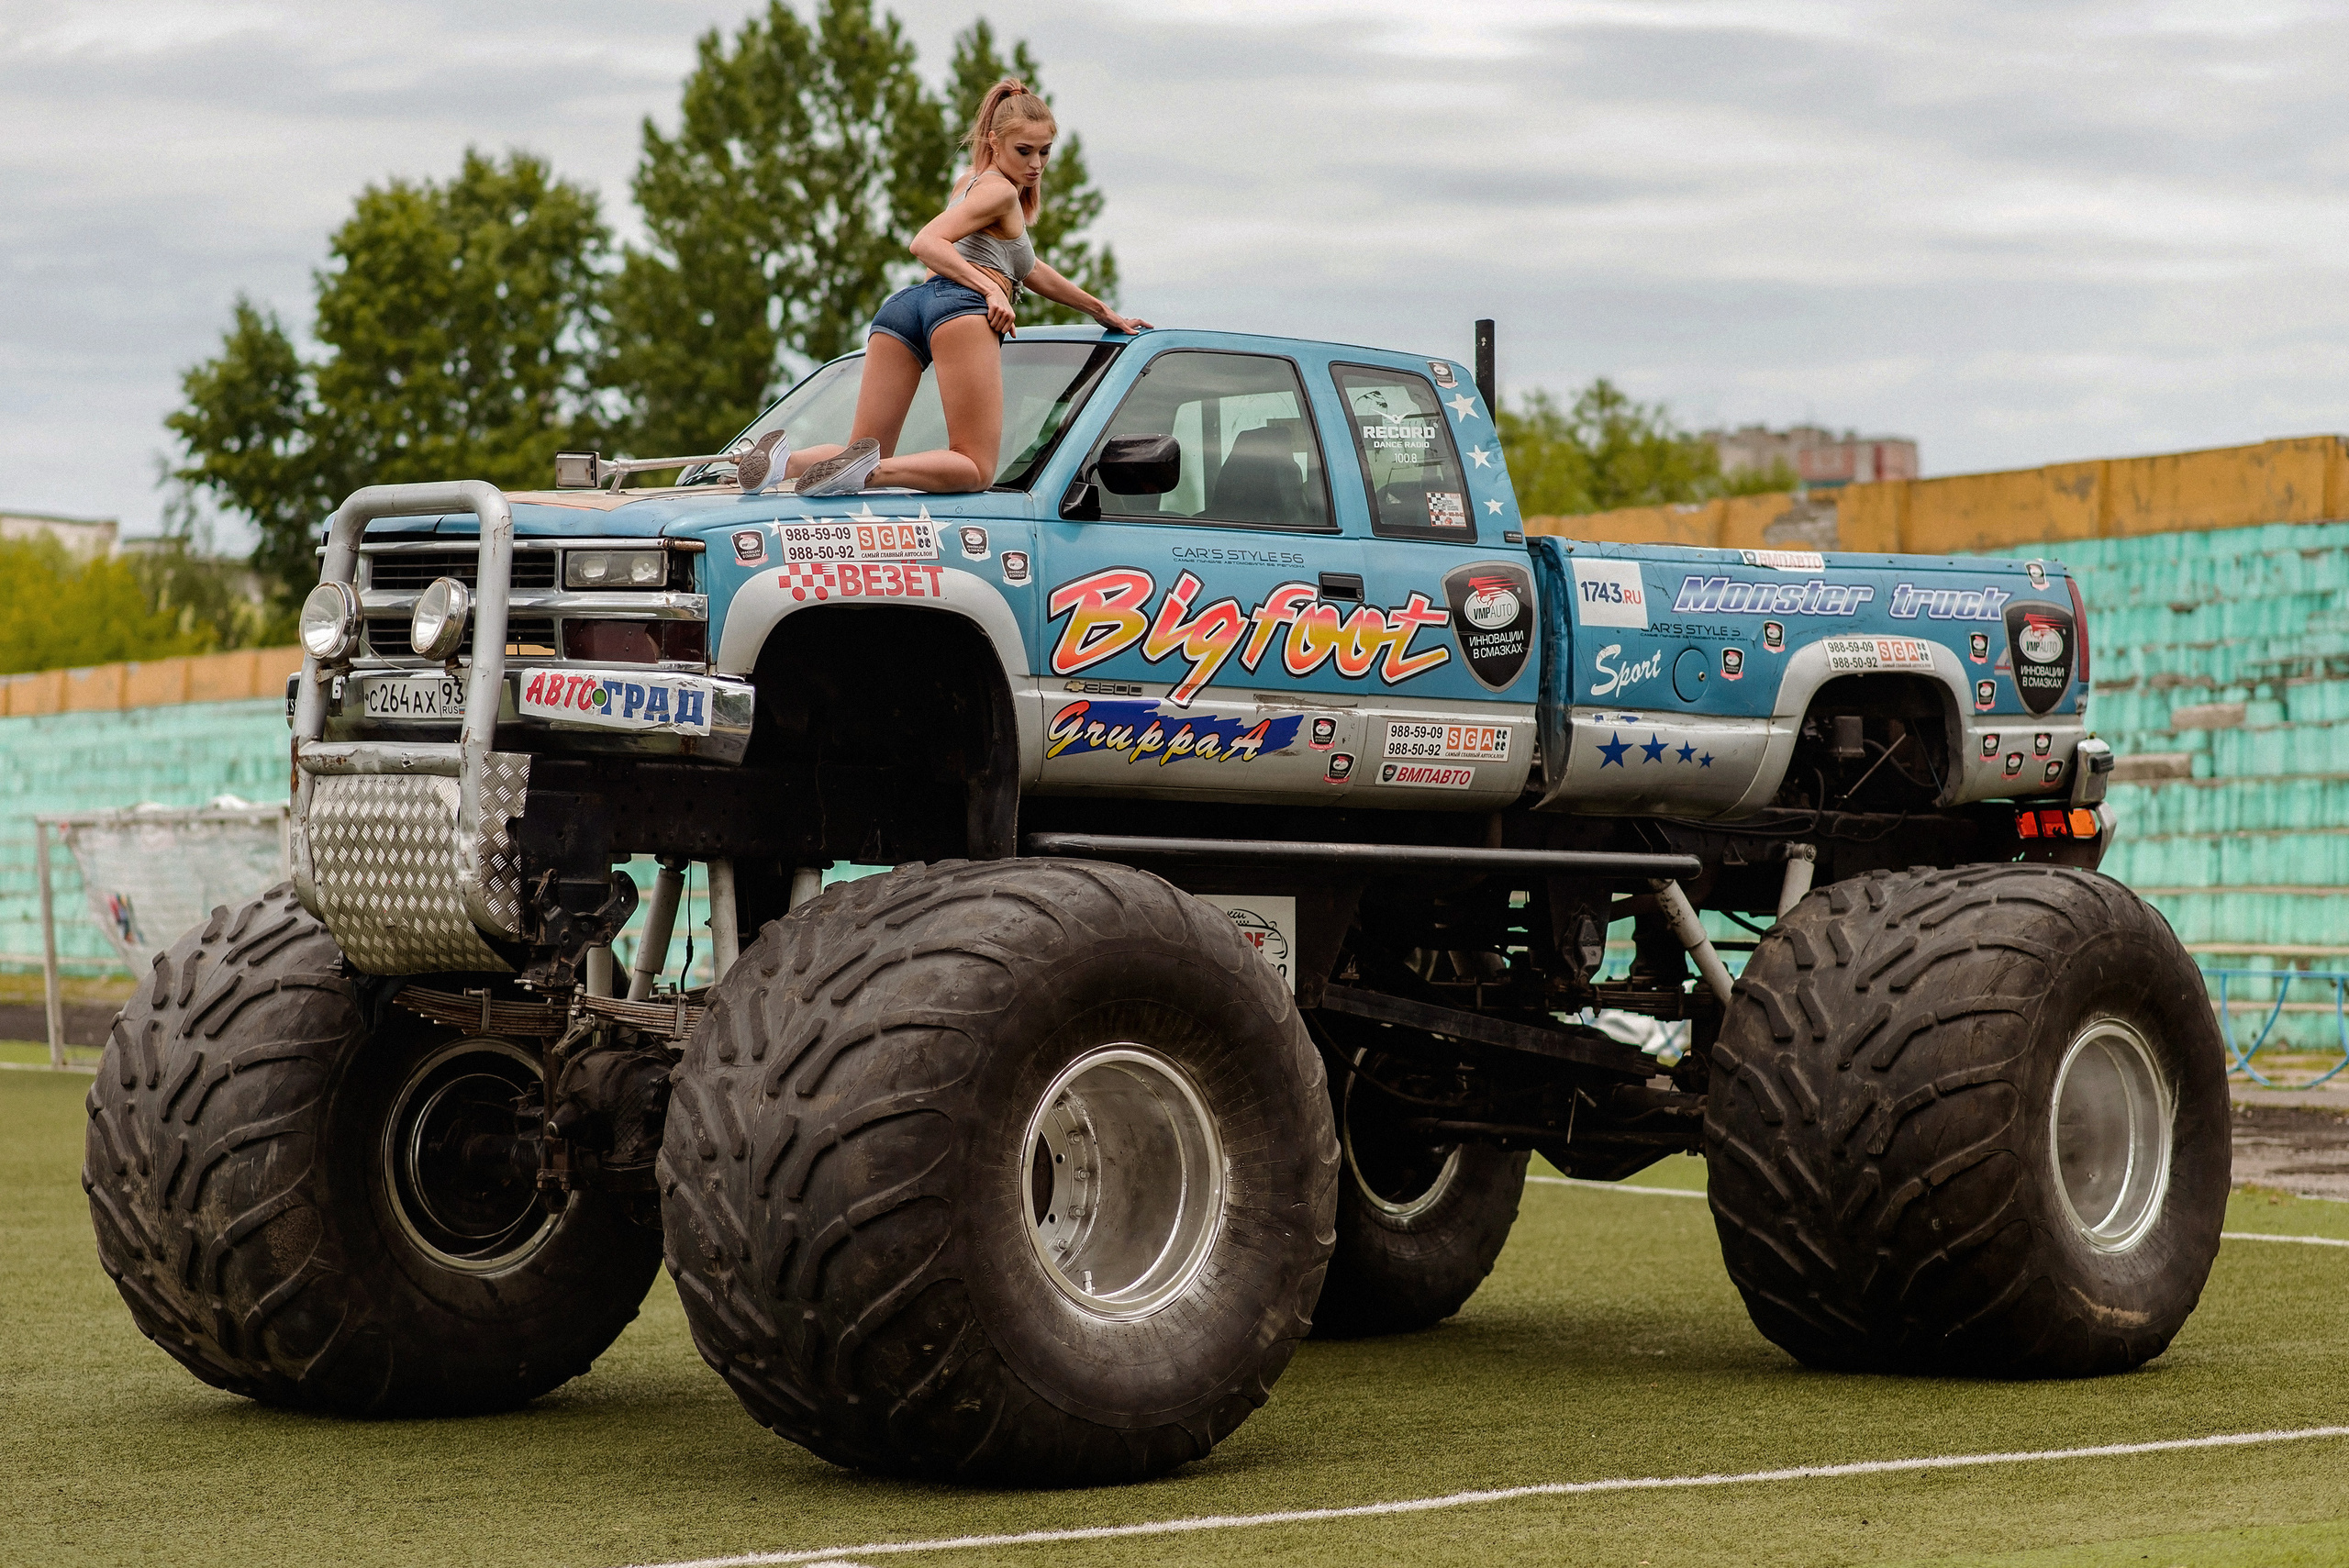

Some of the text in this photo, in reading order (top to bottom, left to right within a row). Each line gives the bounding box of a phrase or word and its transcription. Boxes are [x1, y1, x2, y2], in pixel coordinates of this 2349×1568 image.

[1364, 426, 1436, 439] RECORD
[1394, 453, 1418, 462] 100.8
[785, 527, 852, 541] 988-59-09
[859, 527, 916, 549] SGA
[788, 545, 855, 561] 988-50-92
[1172, 547, 1304, 563] CAR'S STYLE 56
[1580, 581, 1642, 605] 1743.RU
[1671, 574, 2013, 622] Monster truck
[1048, 567, 1451, 706] Bigfoot
[1469, 629, 1524, 647] ИННОВАЦИИ
[1686, 624, 1728, 636] STYLE
[1473, 643, 1523, 660] В СМАЗКАХ
[1827, 641, 1874, 652] 988-59-09
[1878, 642, 1919, 660] SGA
[1832, 656, 1878, 668] 988-50-92
[1590, 644, 1662, 698] Sport
[2021, 664, 2065, 677] ИННОВАЦИИ
[1084, 681, 1143, 696] 3500
[2022, 677, 2063, 688] В СМАЗКАХ
[444, 682, 464, 706] 93
[442, 706, 459, 714] RUS
[1046, 699, 1223, 767] Gruppa
[1390, 725, 1443, 739] 988-59-09
[1447, 728, 1494, 749] SGA
[1388, 742, 1442, 756] 988-50-92
[1396, 766, 1471, 785] ВМПАВТО
